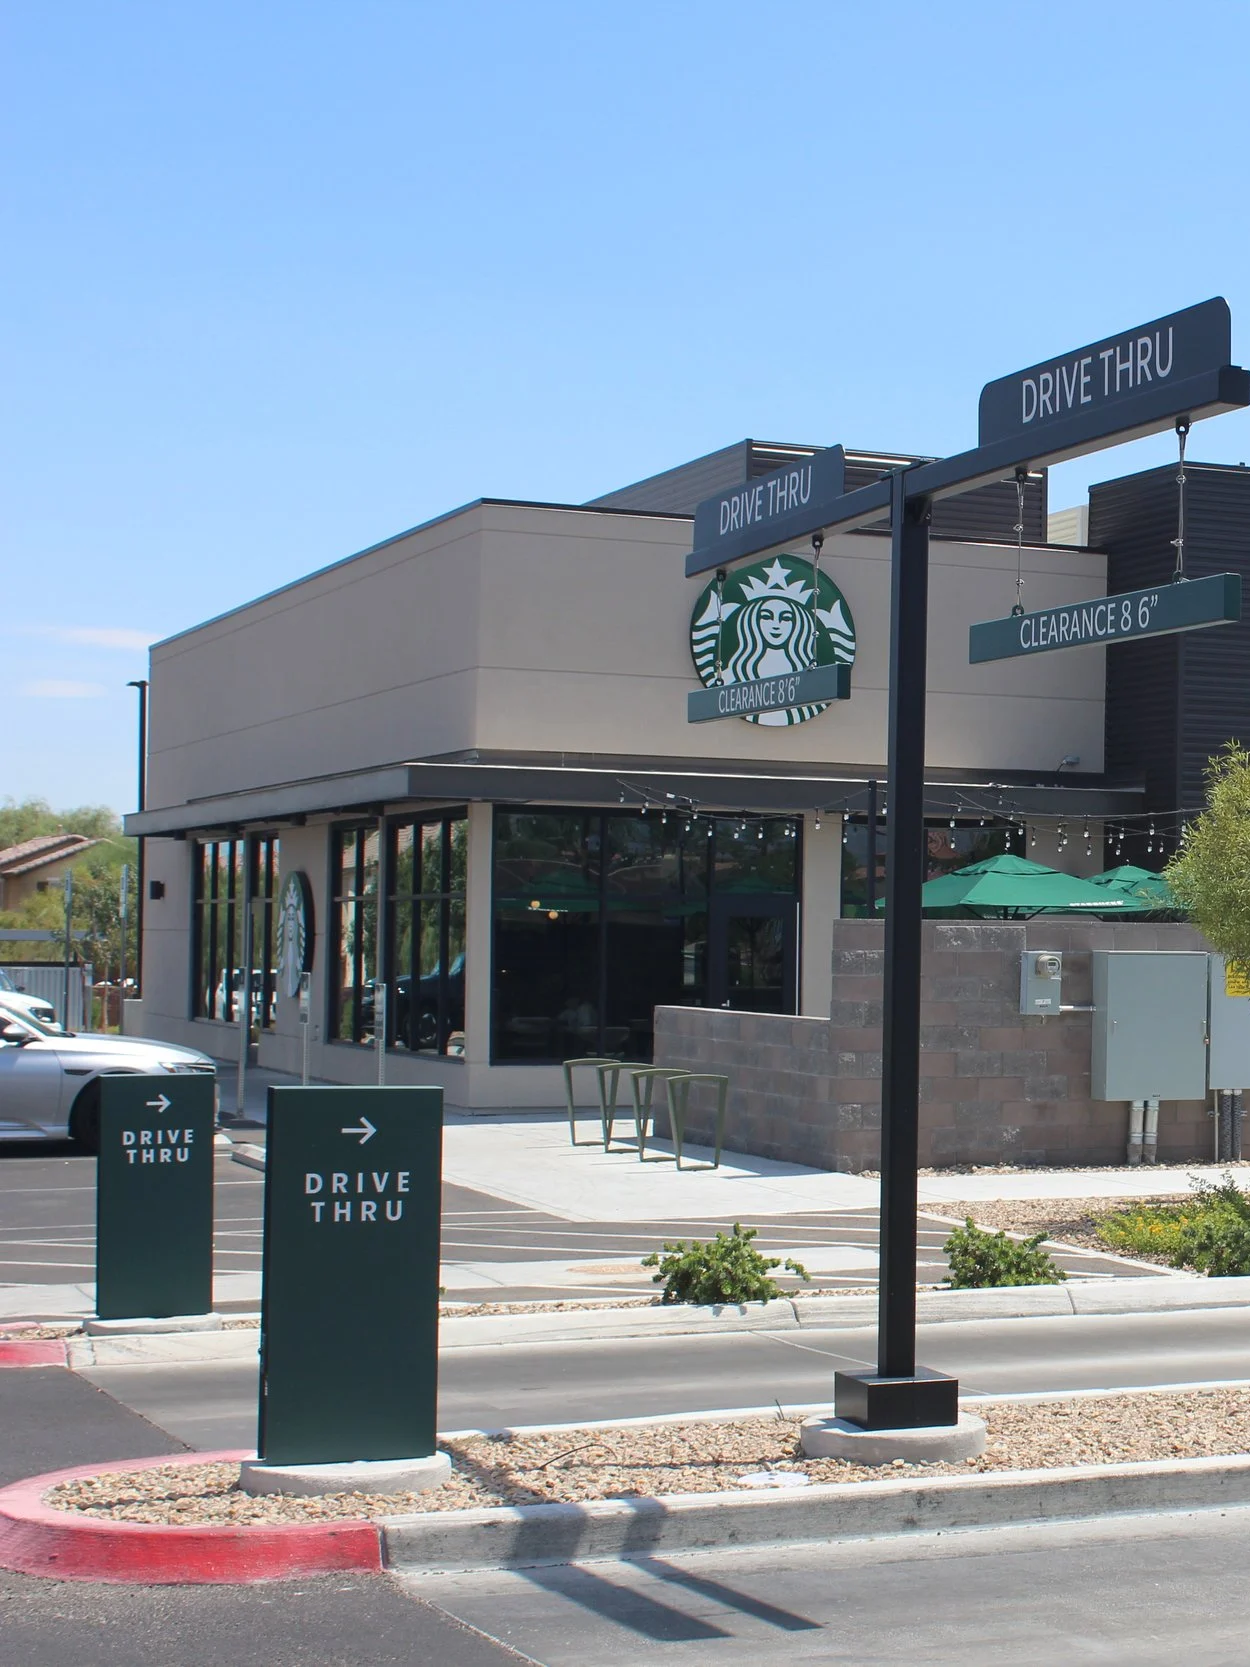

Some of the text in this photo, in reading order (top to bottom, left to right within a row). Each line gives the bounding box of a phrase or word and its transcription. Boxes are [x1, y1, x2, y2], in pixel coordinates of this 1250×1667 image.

[1022, 326, 1173, 424] DRIVE THRU
[720, 465, 812, 535] DRIVE THRU
[1020, 602, 1116, 649] CLEARANCE
[718, 681, 776, 713] CLEARANCE
[122, 1129, 194, 1146] DRIVE
[126, 1147, 190, 1164] THRU
[305, 1171, 410, 1194] DRIVE
[311, 1200, 403, 1223] THRU
